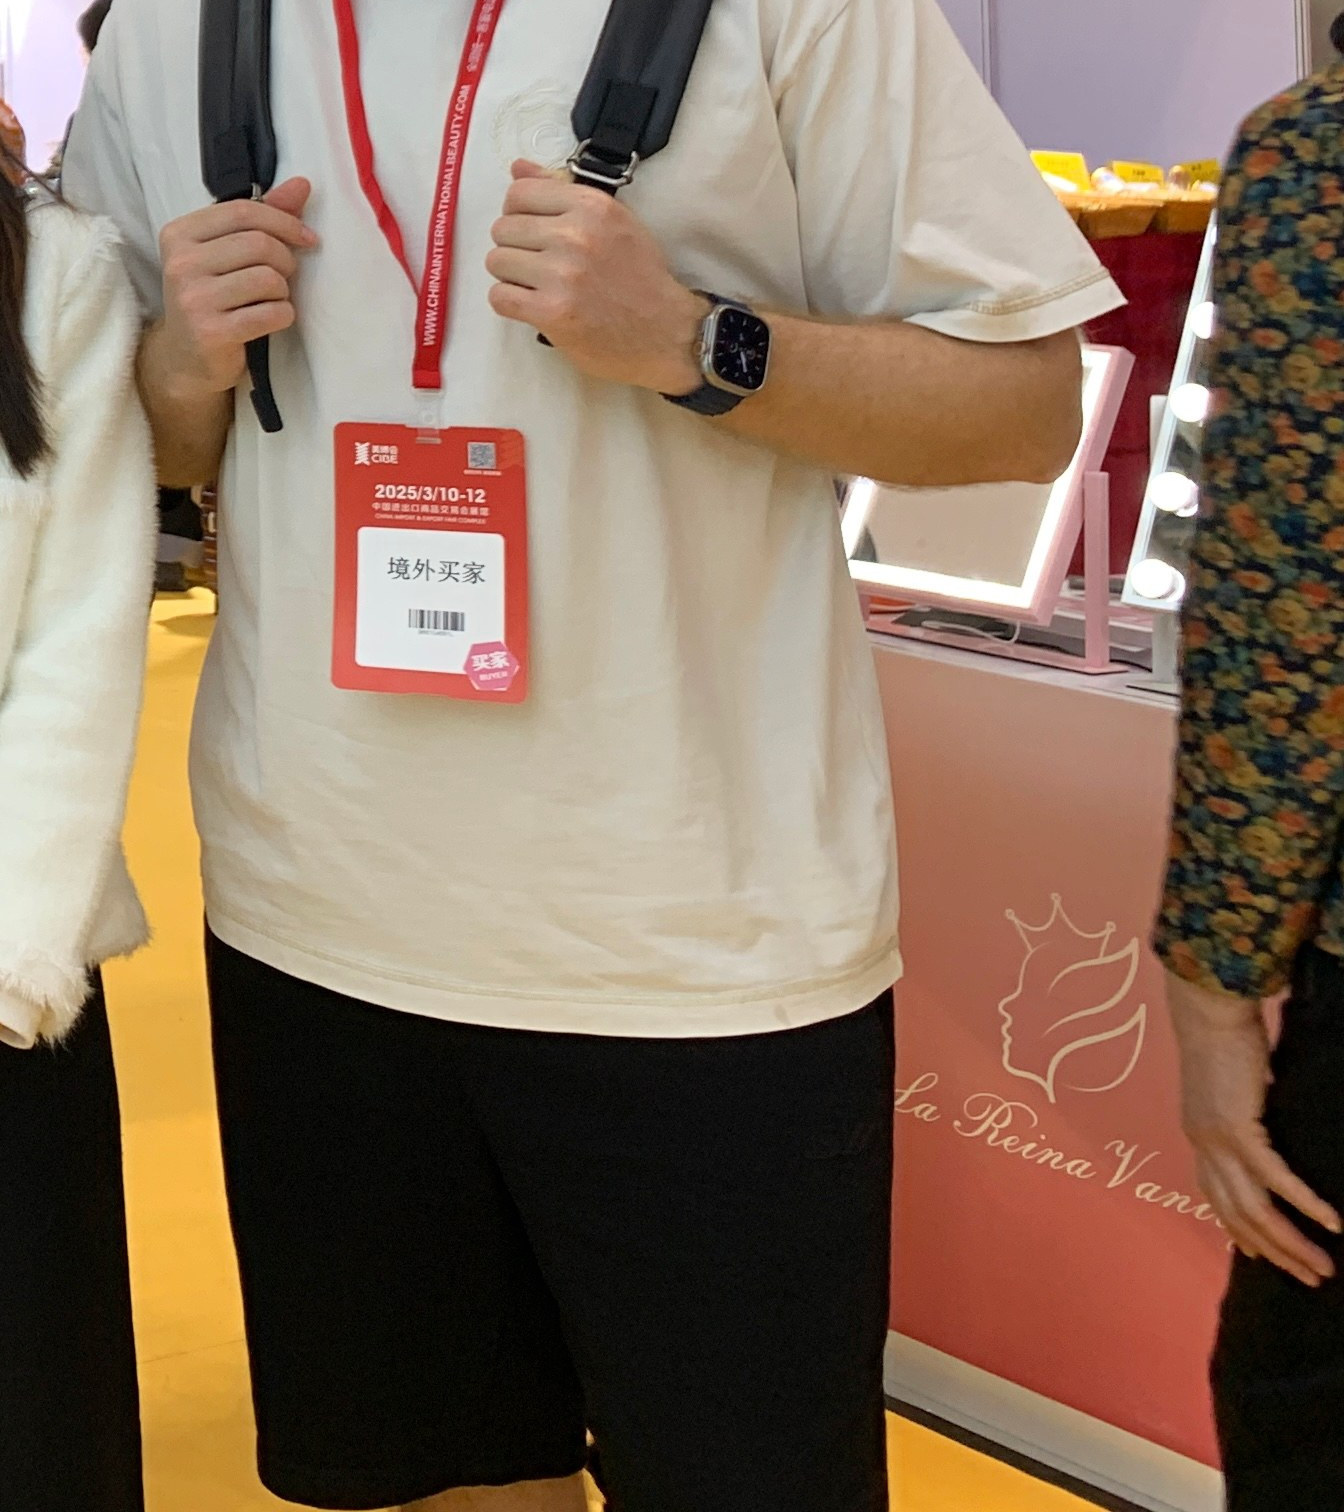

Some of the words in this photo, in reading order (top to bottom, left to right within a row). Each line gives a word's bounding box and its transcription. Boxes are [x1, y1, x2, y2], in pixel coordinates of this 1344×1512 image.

[422, 83, 471, 348] WWW.CHINAINTERNATIONALBEAUTY.COM
[371, 454, 399, 464] CIBE
[375, 484, 486, 504] 2025/3/10-12
[388, 556, 486, 584] 境外买家
[472, 652, 510, 670] 买家
[953, 1092, 1097, 1179] Reina
